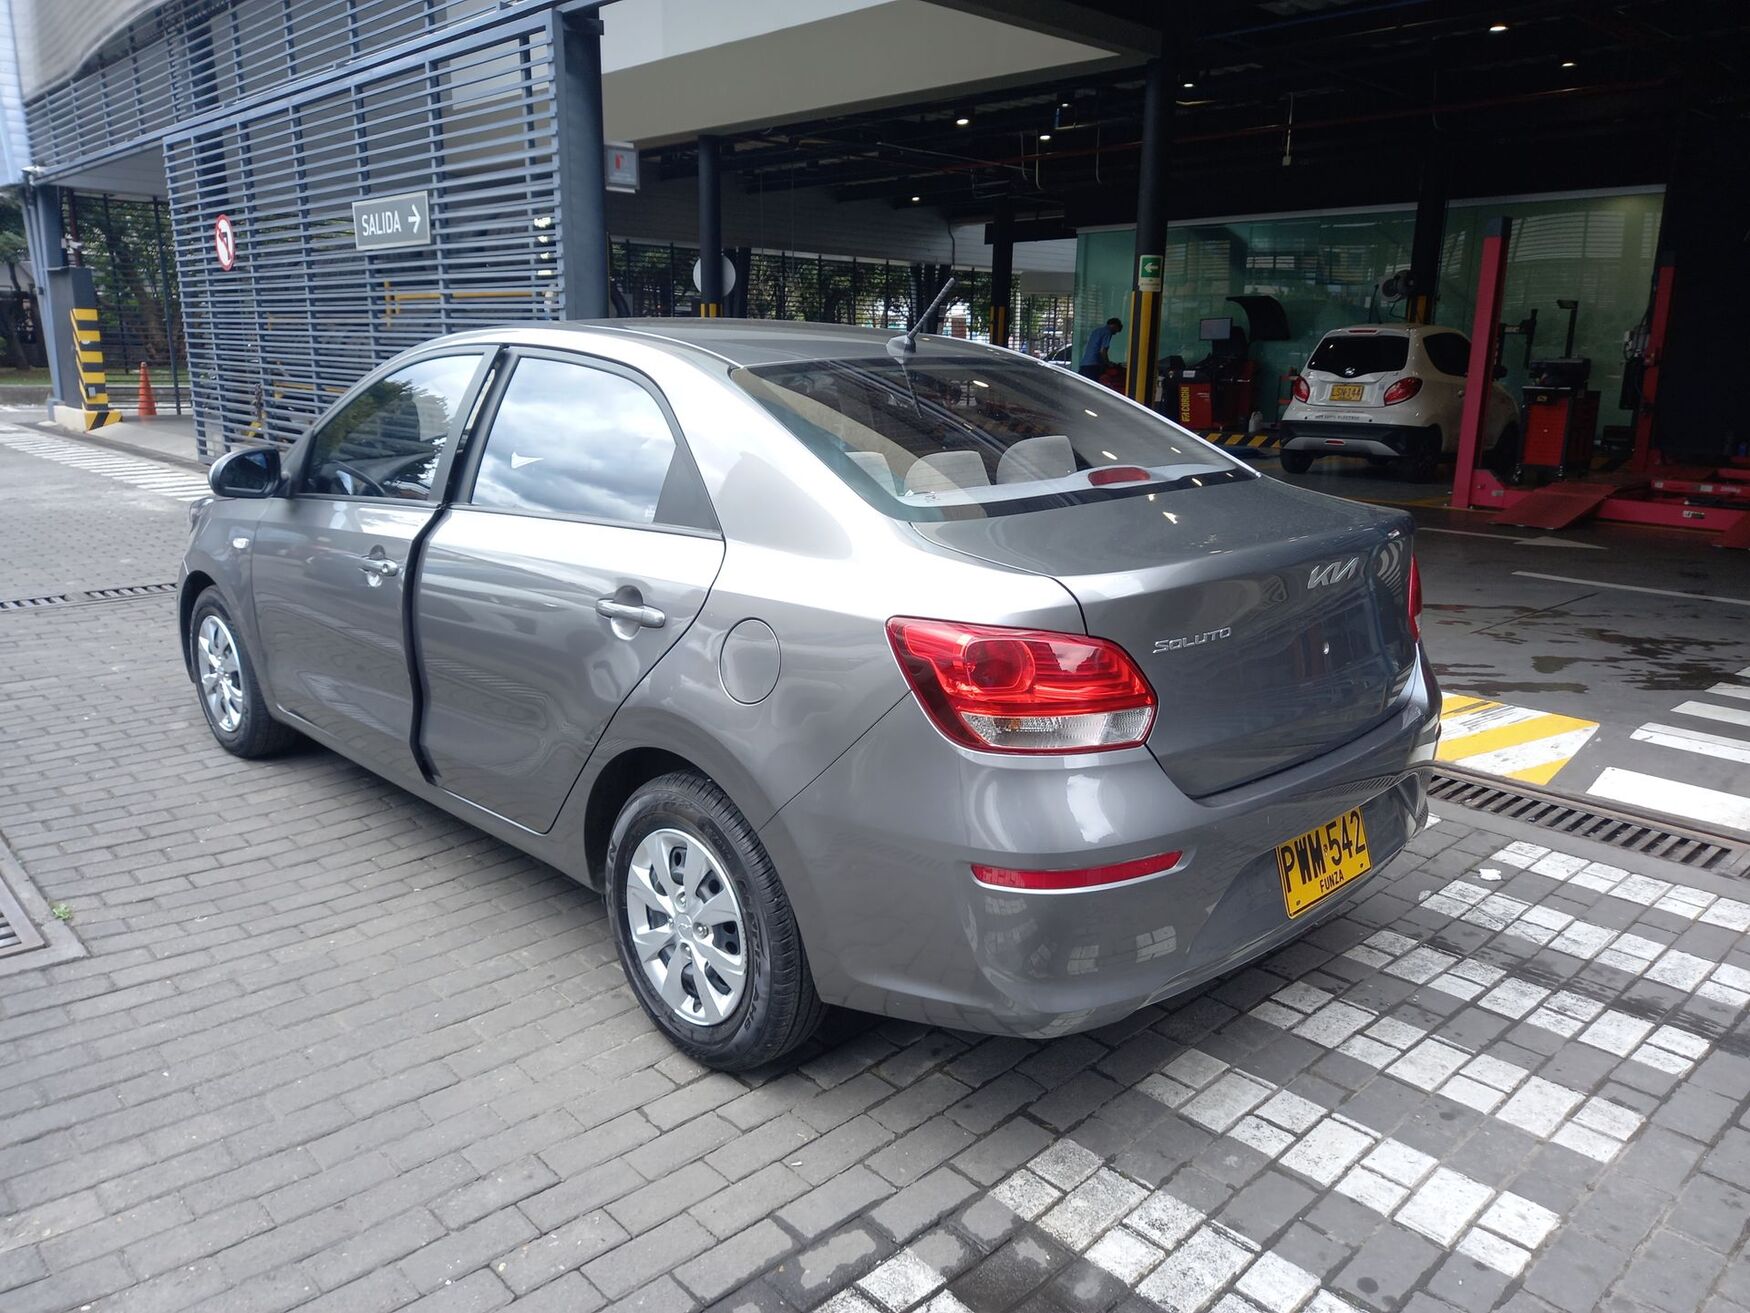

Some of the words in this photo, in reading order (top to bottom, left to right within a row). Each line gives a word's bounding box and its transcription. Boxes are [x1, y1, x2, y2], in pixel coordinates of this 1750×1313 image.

[361, 210, 402, 236] SALIDA
[1153, 626, 1232, 653] SOLUTO
[1281, 829, 1327, 893] PWM
[1325, 810, 1366, 866] 542
[1319, 869, 1345, 893] FUNZA
